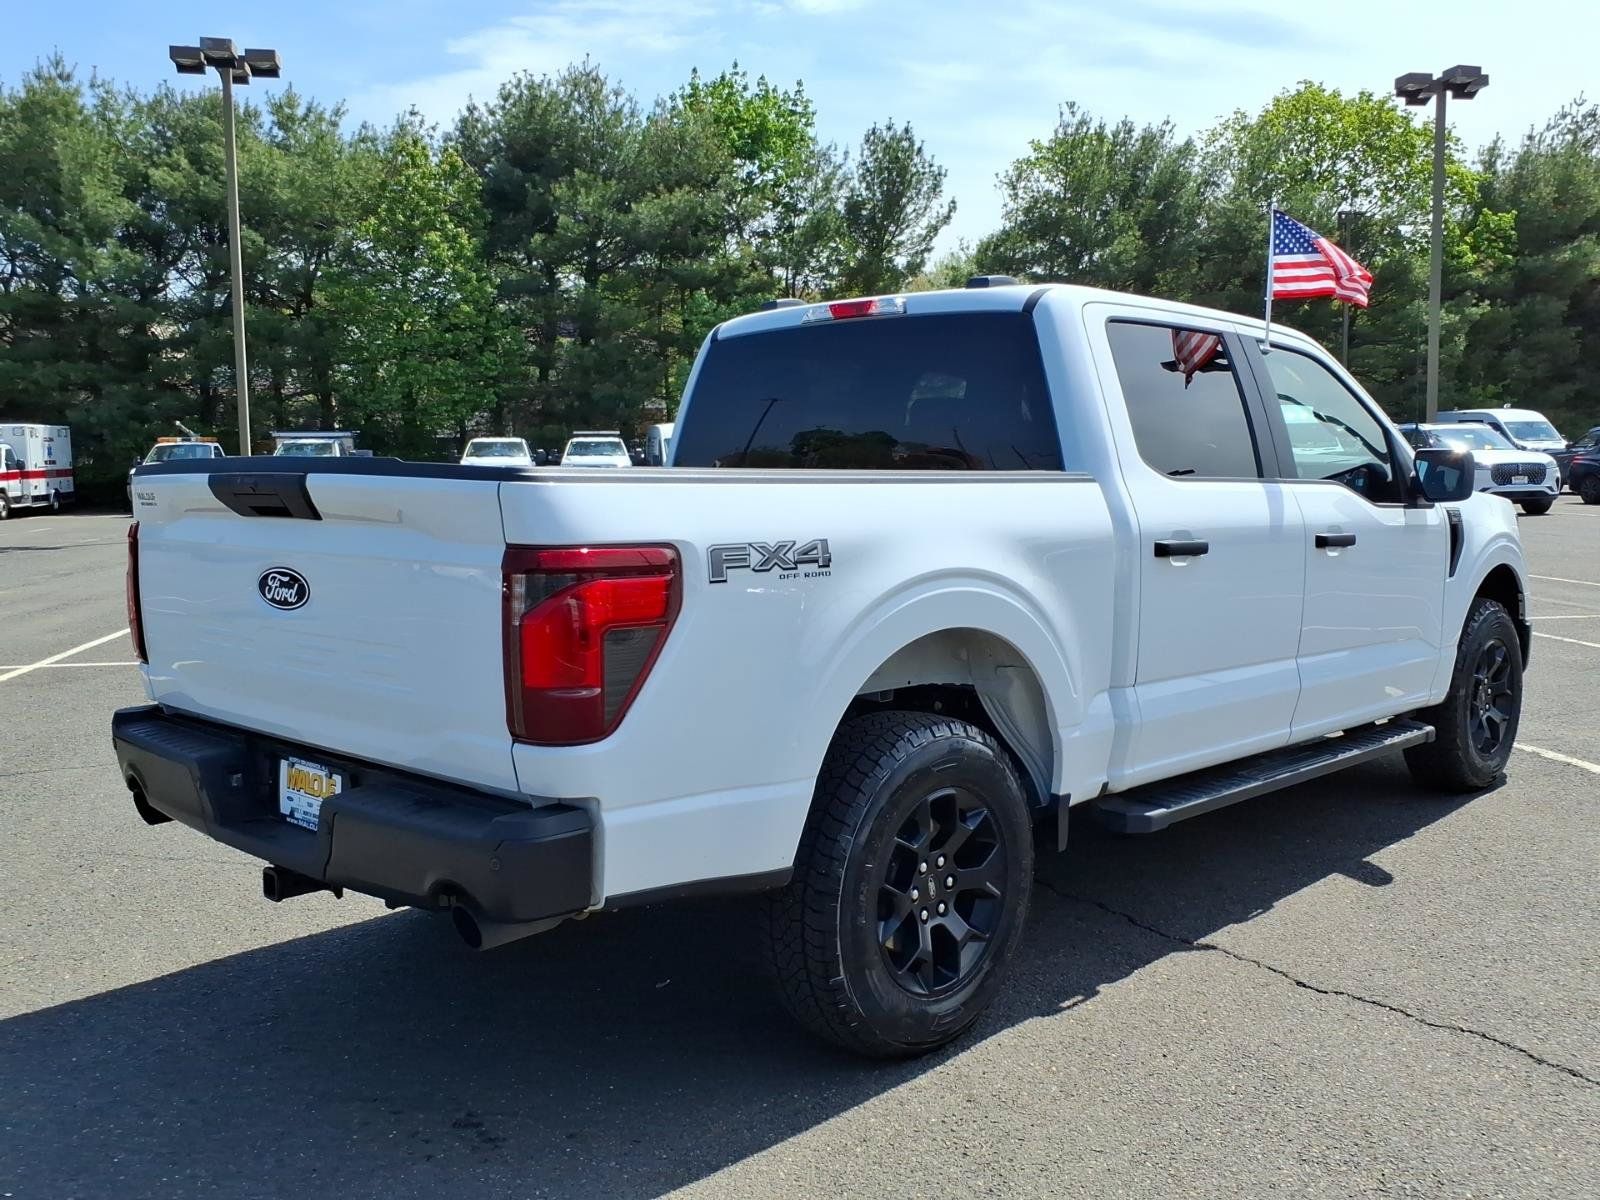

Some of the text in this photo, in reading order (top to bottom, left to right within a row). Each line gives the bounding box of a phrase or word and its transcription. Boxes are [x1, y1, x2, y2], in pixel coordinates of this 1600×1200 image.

[706, 538, 832, 584] FX4
[804, 570, 832, 579] ROAD
[265, 573, 298, 603] Ford
